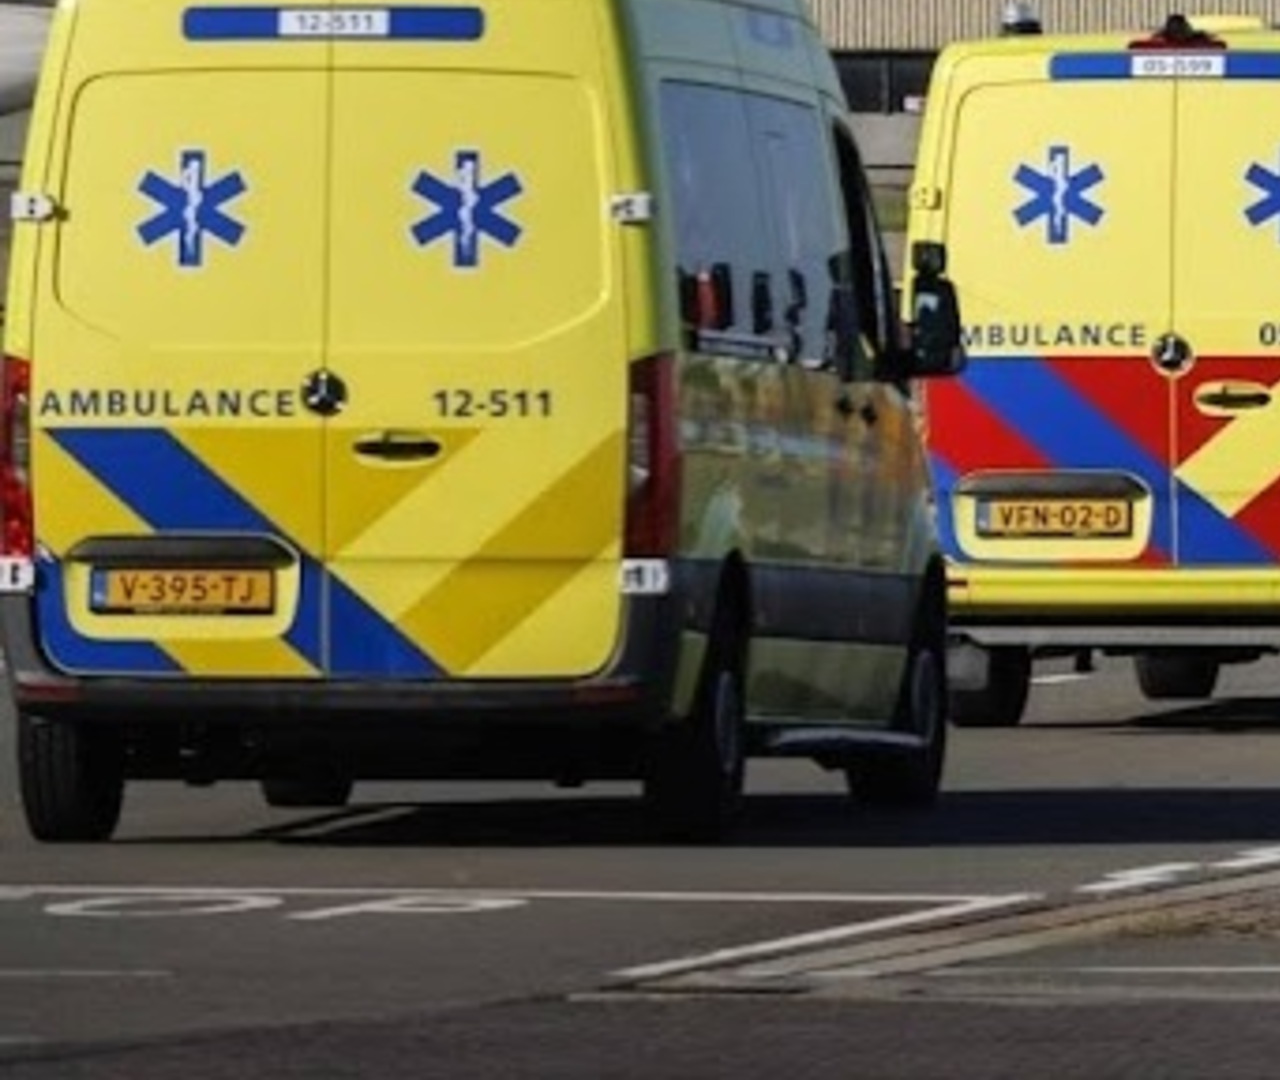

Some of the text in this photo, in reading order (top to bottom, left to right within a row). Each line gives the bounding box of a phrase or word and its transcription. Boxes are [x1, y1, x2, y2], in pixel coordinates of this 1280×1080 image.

[296, 14, 373, 31] 12-511
[960, 323, 1146, 347] MBULANCE
[40, 388, 295, 417] AMBULANCE
[433, 388, 553, 418] 12-511
[1000, 504, 1122, 530] VFN-02-D
[118, 573, 257, 604] V-395-TJ
